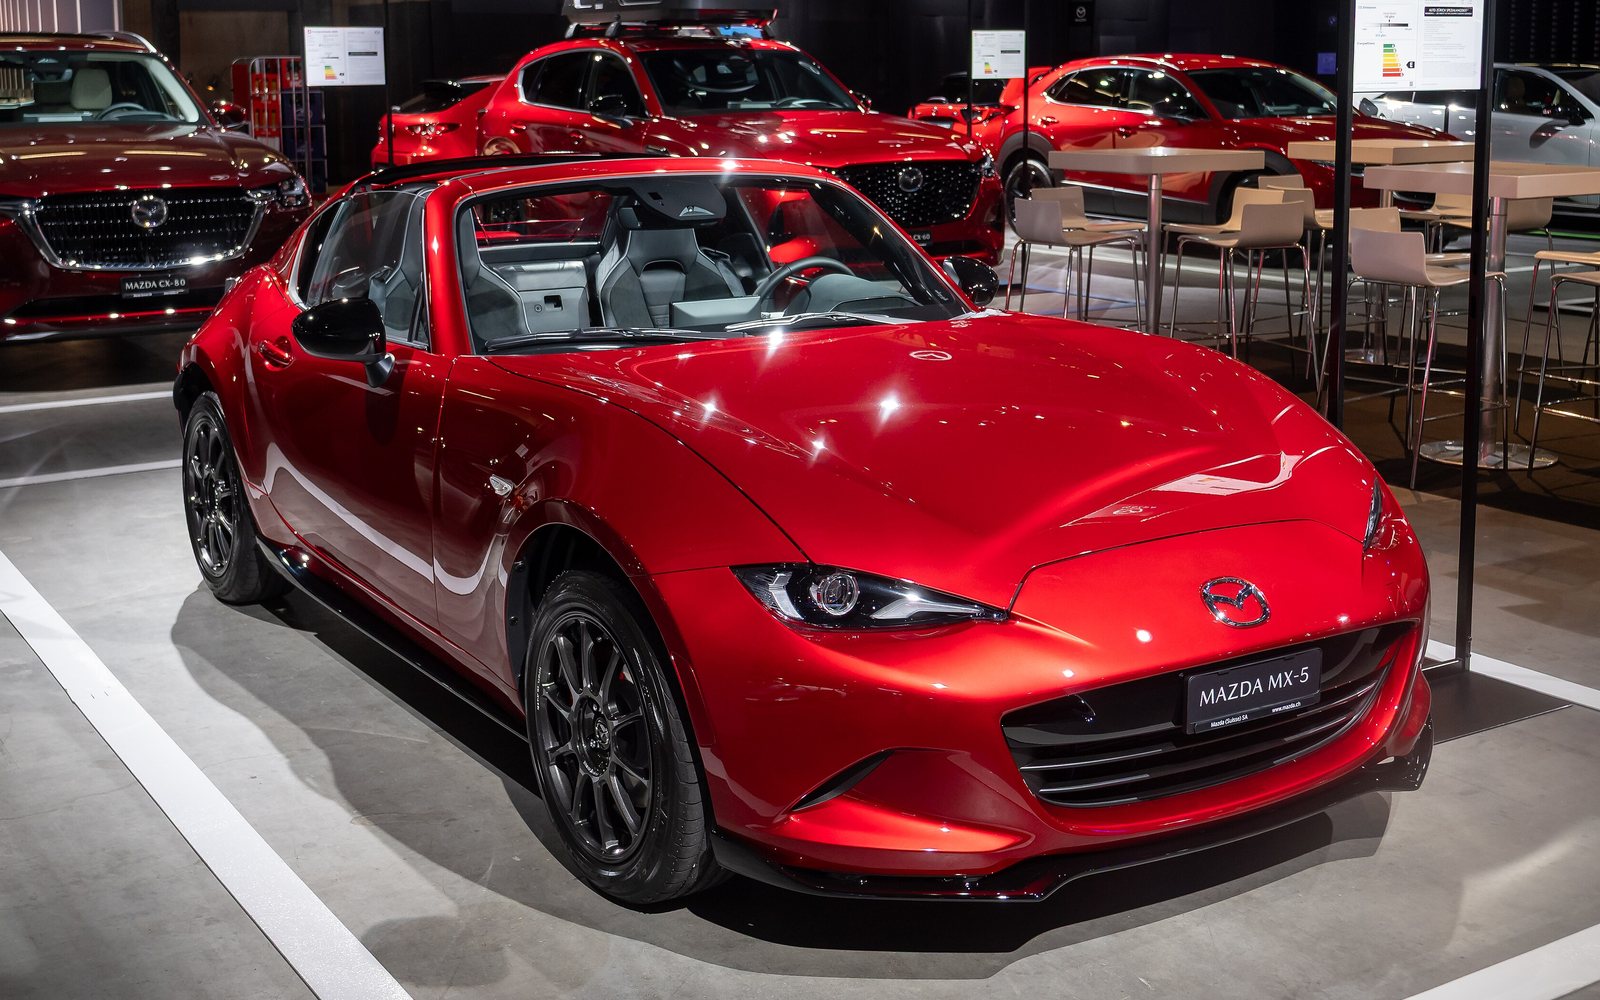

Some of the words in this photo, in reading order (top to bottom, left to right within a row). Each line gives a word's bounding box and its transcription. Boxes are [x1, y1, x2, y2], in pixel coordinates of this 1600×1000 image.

[125, 281, 157, 290] MAZDA
[159, 279, 186, 287] CX-80
[1199, 678, 1263, 707] MAZDA
[1268, 666, 1309, 691] MX-5
[1272, 701, 1301, 713] www.mazda.ch
[1210, 719, 1225, 728] Mazda
[1242, 714, 1248, 722] SA
